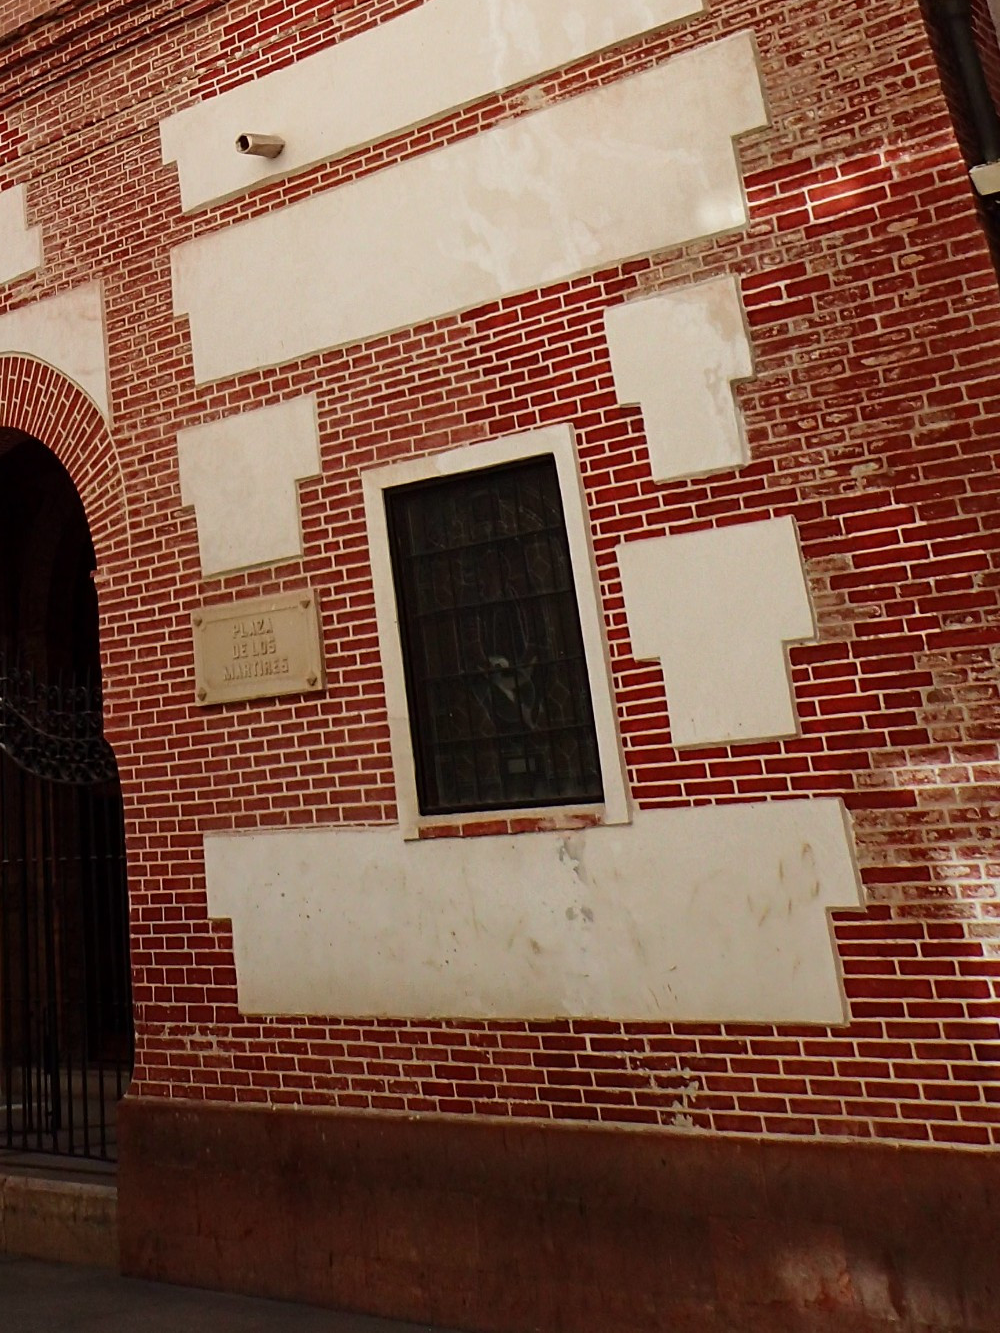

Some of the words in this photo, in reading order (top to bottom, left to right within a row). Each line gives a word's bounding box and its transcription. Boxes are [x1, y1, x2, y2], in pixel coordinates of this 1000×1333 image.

[232, 618, 274, 639] PLAZA
[232, 643, 249, 660] DE
[252, 638, 277, 657] LOS
